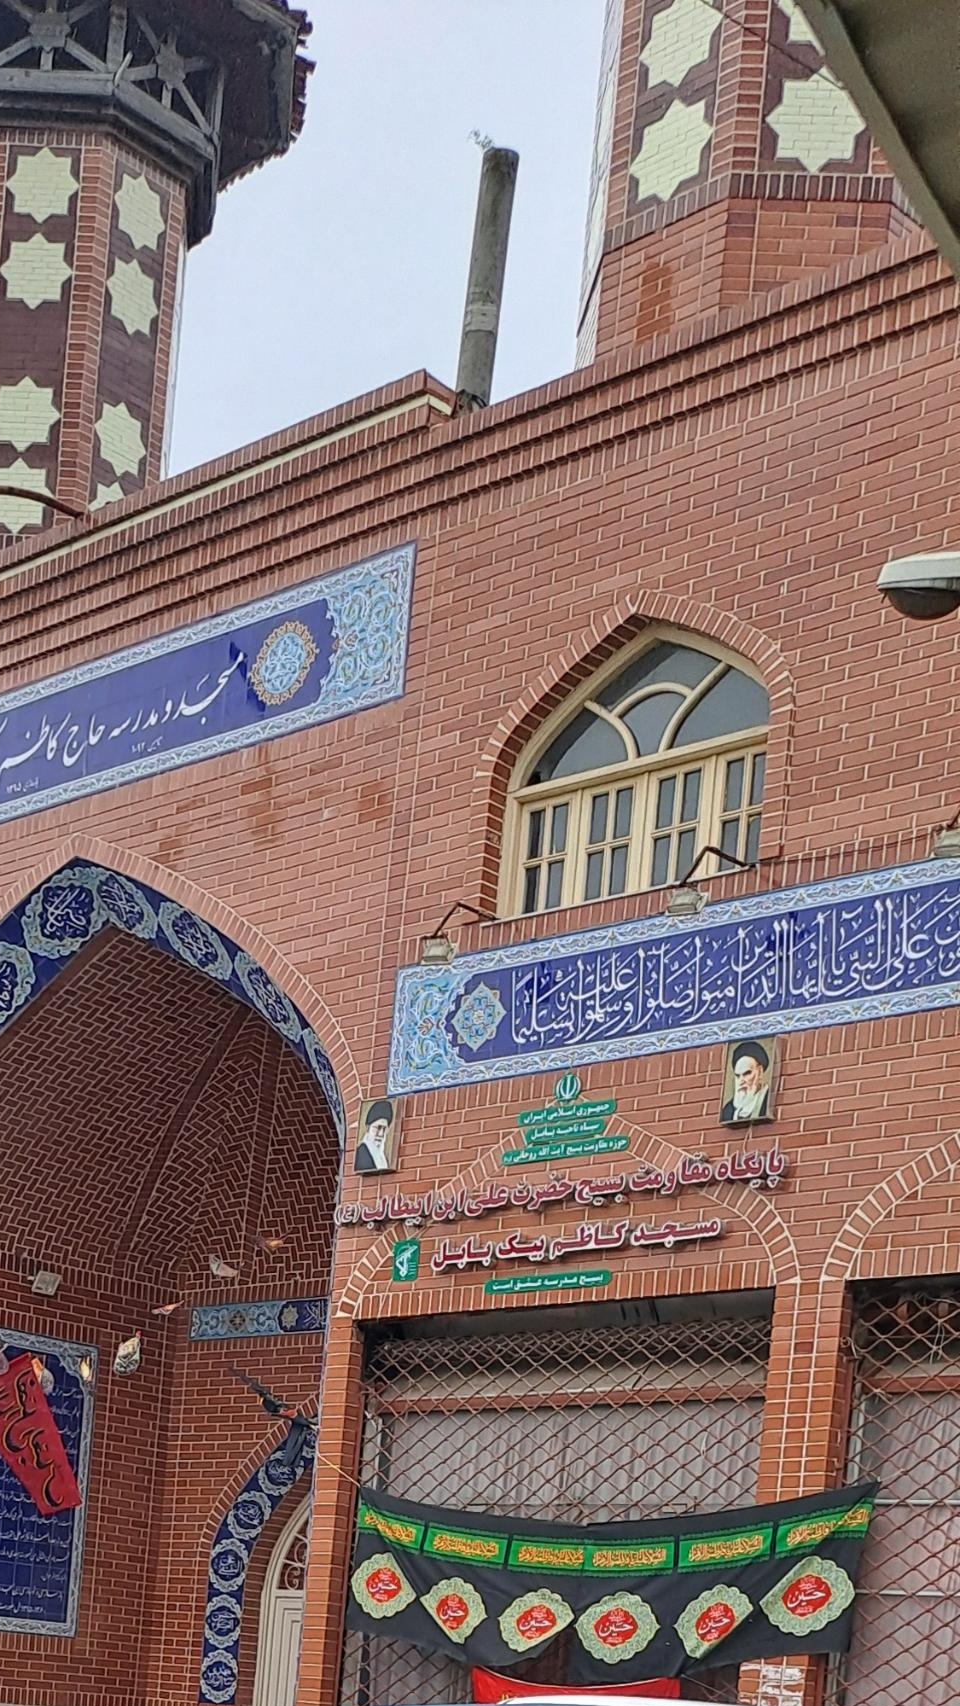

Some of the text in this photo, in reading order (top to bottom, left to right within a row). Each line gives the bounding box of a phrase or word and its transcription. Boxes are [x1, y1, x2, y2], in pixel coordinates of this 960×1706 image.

[173, 651, 244, 724] مسجد
[63, 713, 105, 767] حاج
[108, 708, 159, 740] مدرسه
[523, 1102, 609, 1124] جمهوری اسلامی ایران
[530, 1127, 555, 1141] بابل
[584, 1140, 608, 1153] مقاومت
[629, 1152, 714, 1194] مقاومت
[716, 1148, 785, 1189] پایگاه
[432, 1187, 467, 1221] ابن
[464, 1182, 508, 1217] علی
[510, 1172, 573, 1211] حضرت
[575, 1173, 626, 1206] بسیج
[431, 1217, 722, 1272] مسجد کاظم بیک بابل
[492, 1273, 604, 1291] بسیج مدرسه عشق است
[787, 1588, 826, 1608] حسین
[598, 1619, 634, 1638] حسین
